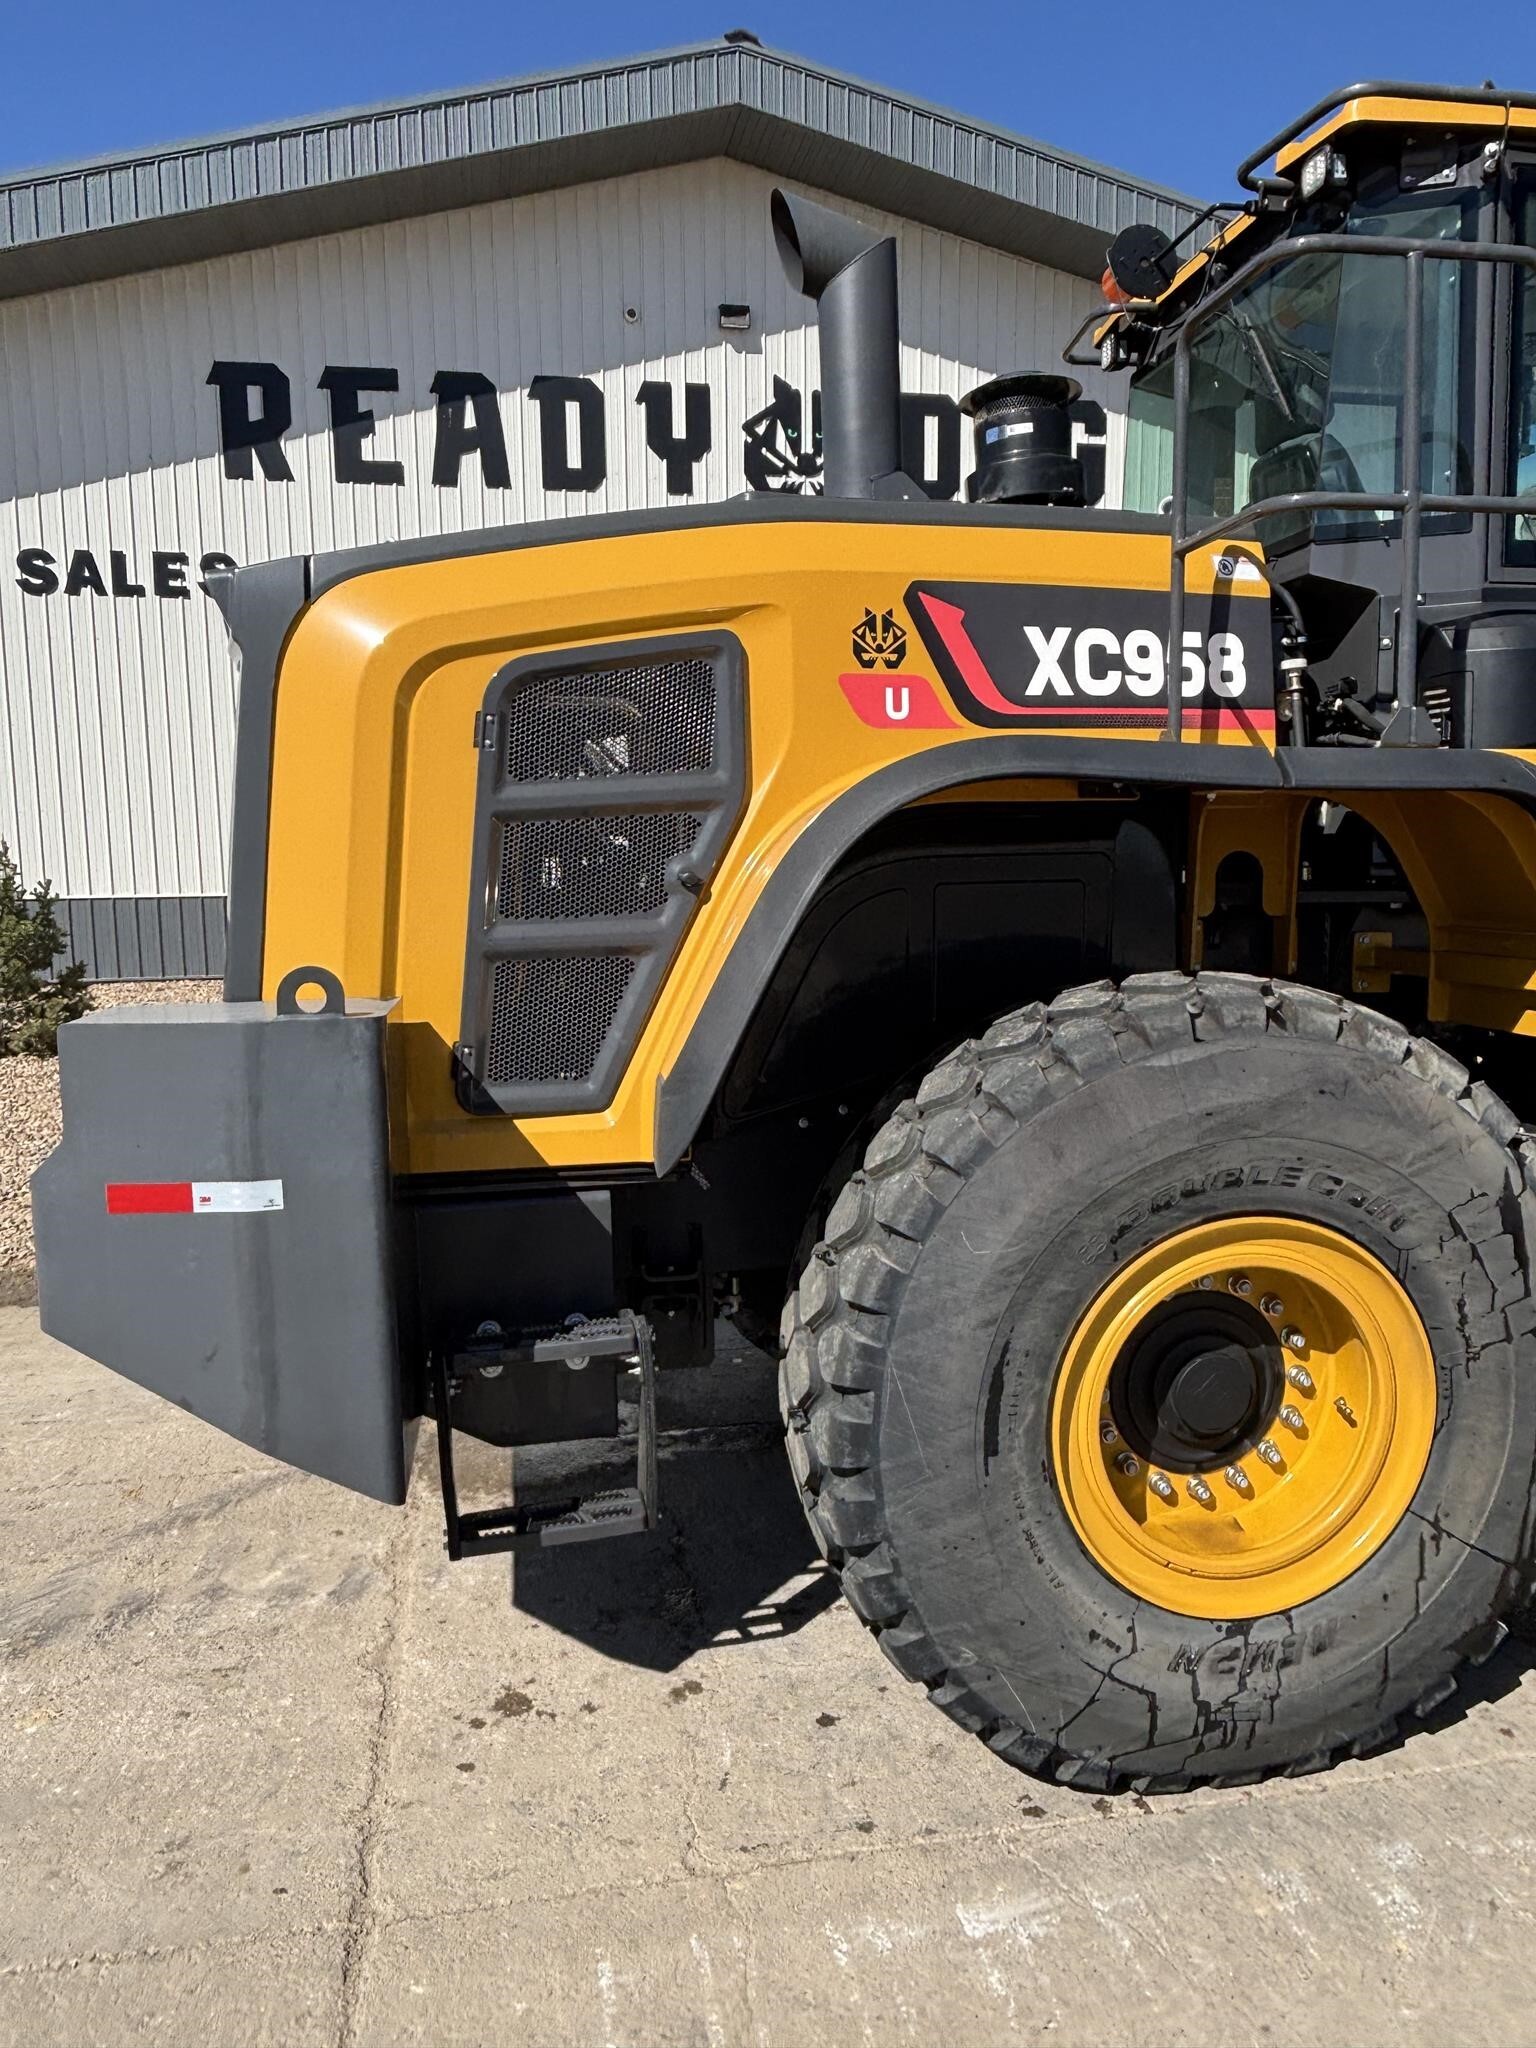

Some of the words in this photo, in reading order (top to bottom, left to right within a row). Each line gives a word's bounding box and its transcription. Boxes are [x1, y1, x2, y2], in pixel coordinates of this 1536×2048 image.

[206, 361, 710, 495] READY
[1023, 626, 1247, 698] XC958
[885, 687, 909, 720] U
